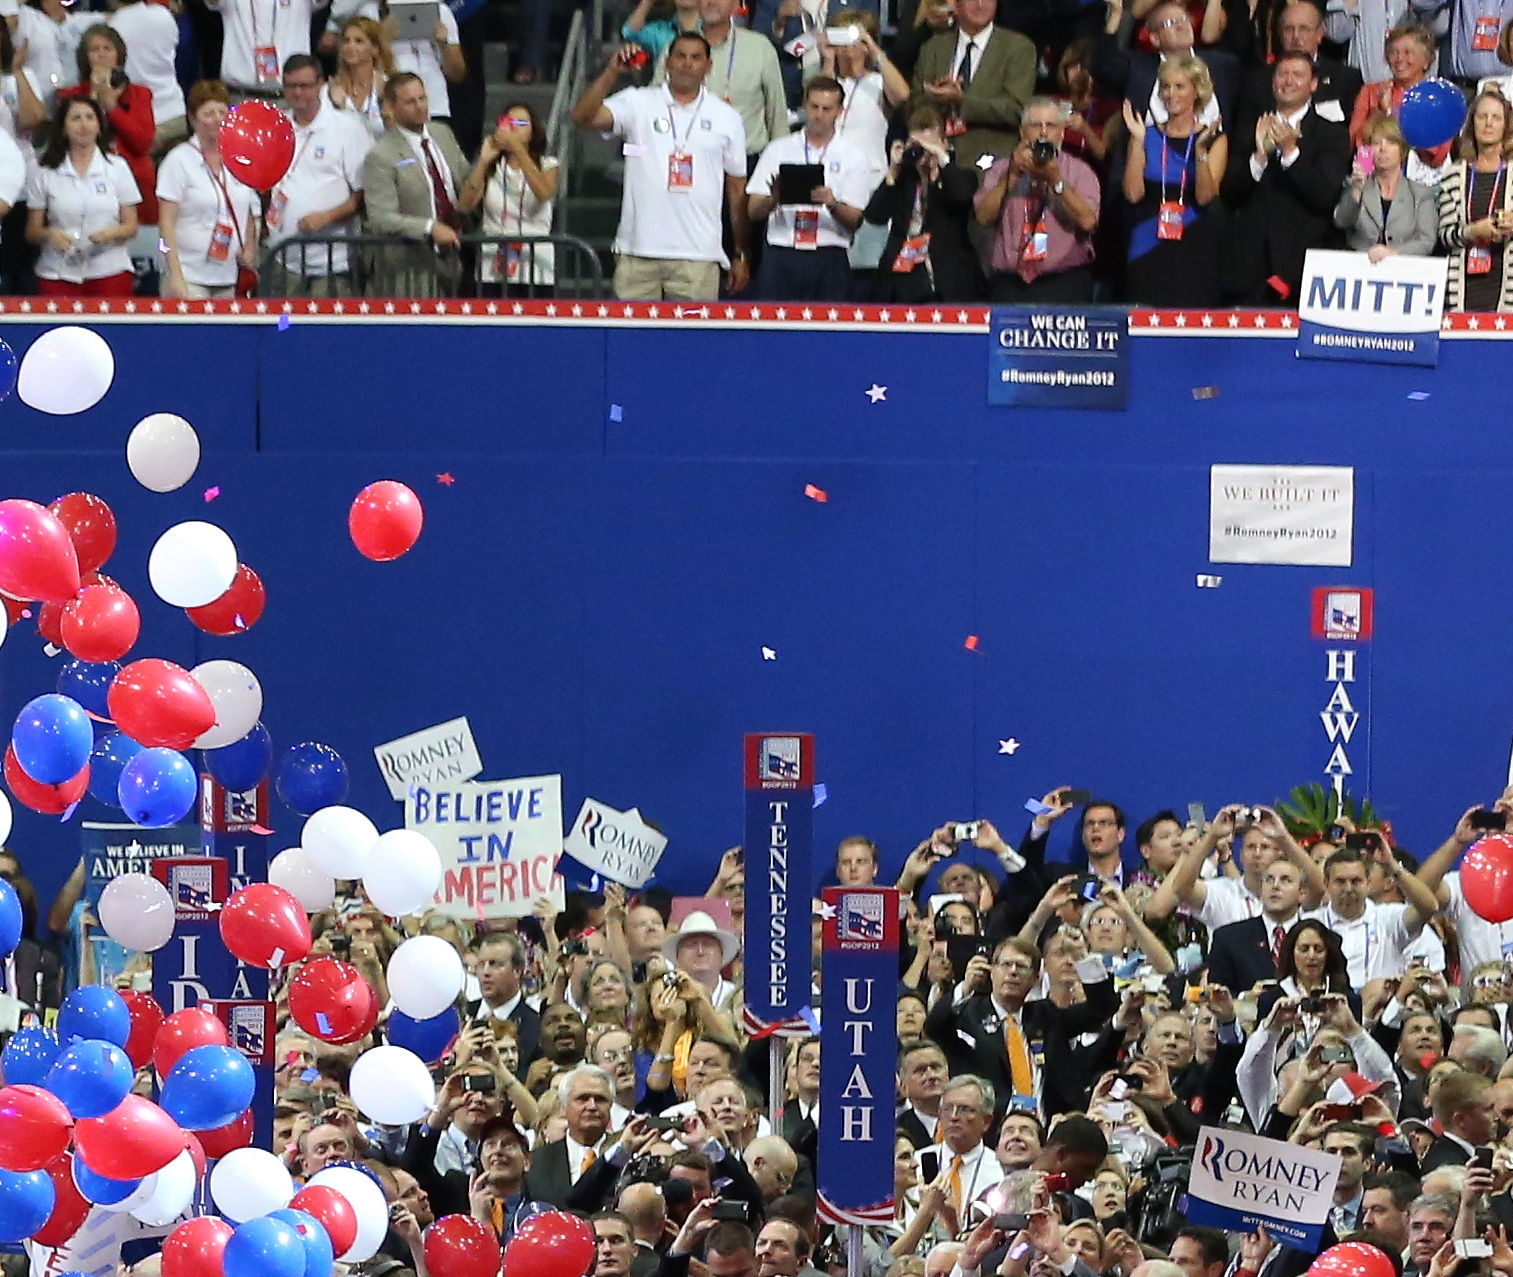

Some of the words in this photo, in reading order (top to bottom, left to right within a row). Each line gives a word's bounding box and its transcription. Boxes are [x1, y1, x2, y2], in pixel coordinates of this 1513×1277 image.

[1307, 276, 1436, 316] MITT!
[999, 328, 1090, 349] CHANGE
[1096, 331, 1119, 350] IT
[1031, 315, 1053, 330] WE
[1056, 316, 1086, 330] CAN
[1001, 369, 1115, 386] #RomneyRyan2012
[1224, 485, 1252, 501] WE
[1260, 487, 1314, 502] BUILT
[1322, 489, 1340, 502] IT
[1225, 525, 1337, 539] #RomneyRyan2012
[382, 732, 466, 783] ROMNEY
[415, 787, 544, 824] BELIEVE
[172, 844, 184, 856] IN
[458, 831, 514, 864] IN
[580, 808, 661, 862] ROMNEY
[601, 848, 642, 881] RYAN
[769, 802, 789, 1007] TENNESSEE
[840, 978, 875, 1141] UTAH
[1202, 1136, 1330, 1193] ROMNEY
[1233, 1180, 1305, 1212] RYAN
